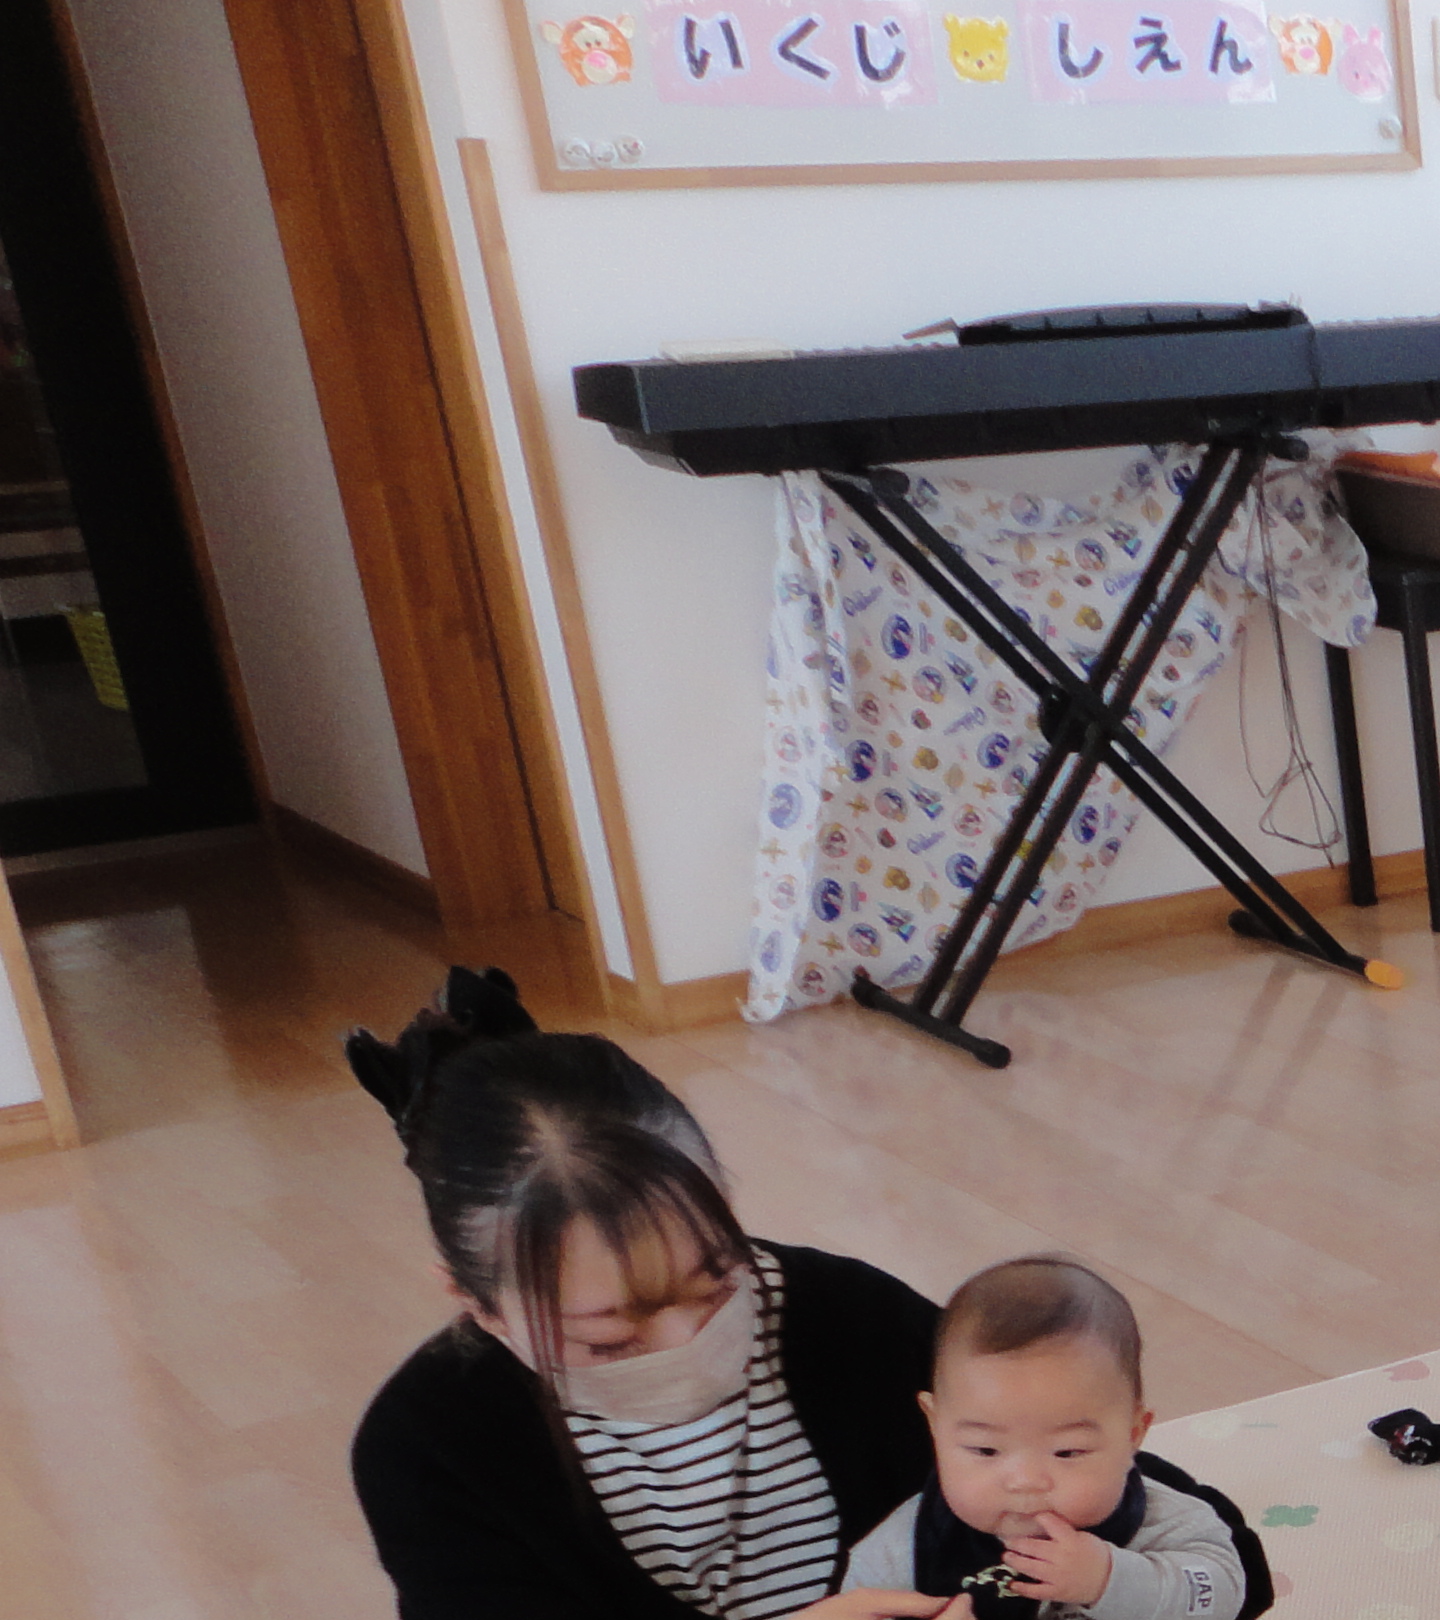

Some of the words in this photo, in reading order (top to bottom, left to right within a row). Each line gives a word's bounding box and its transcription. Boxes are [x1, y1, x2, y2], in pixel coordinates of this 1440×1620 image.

[684, 14, 908, 84] いくじ
[1055, 16, 1255, 78] しえん
[1193, 1571, 1212, 1608] GAP
